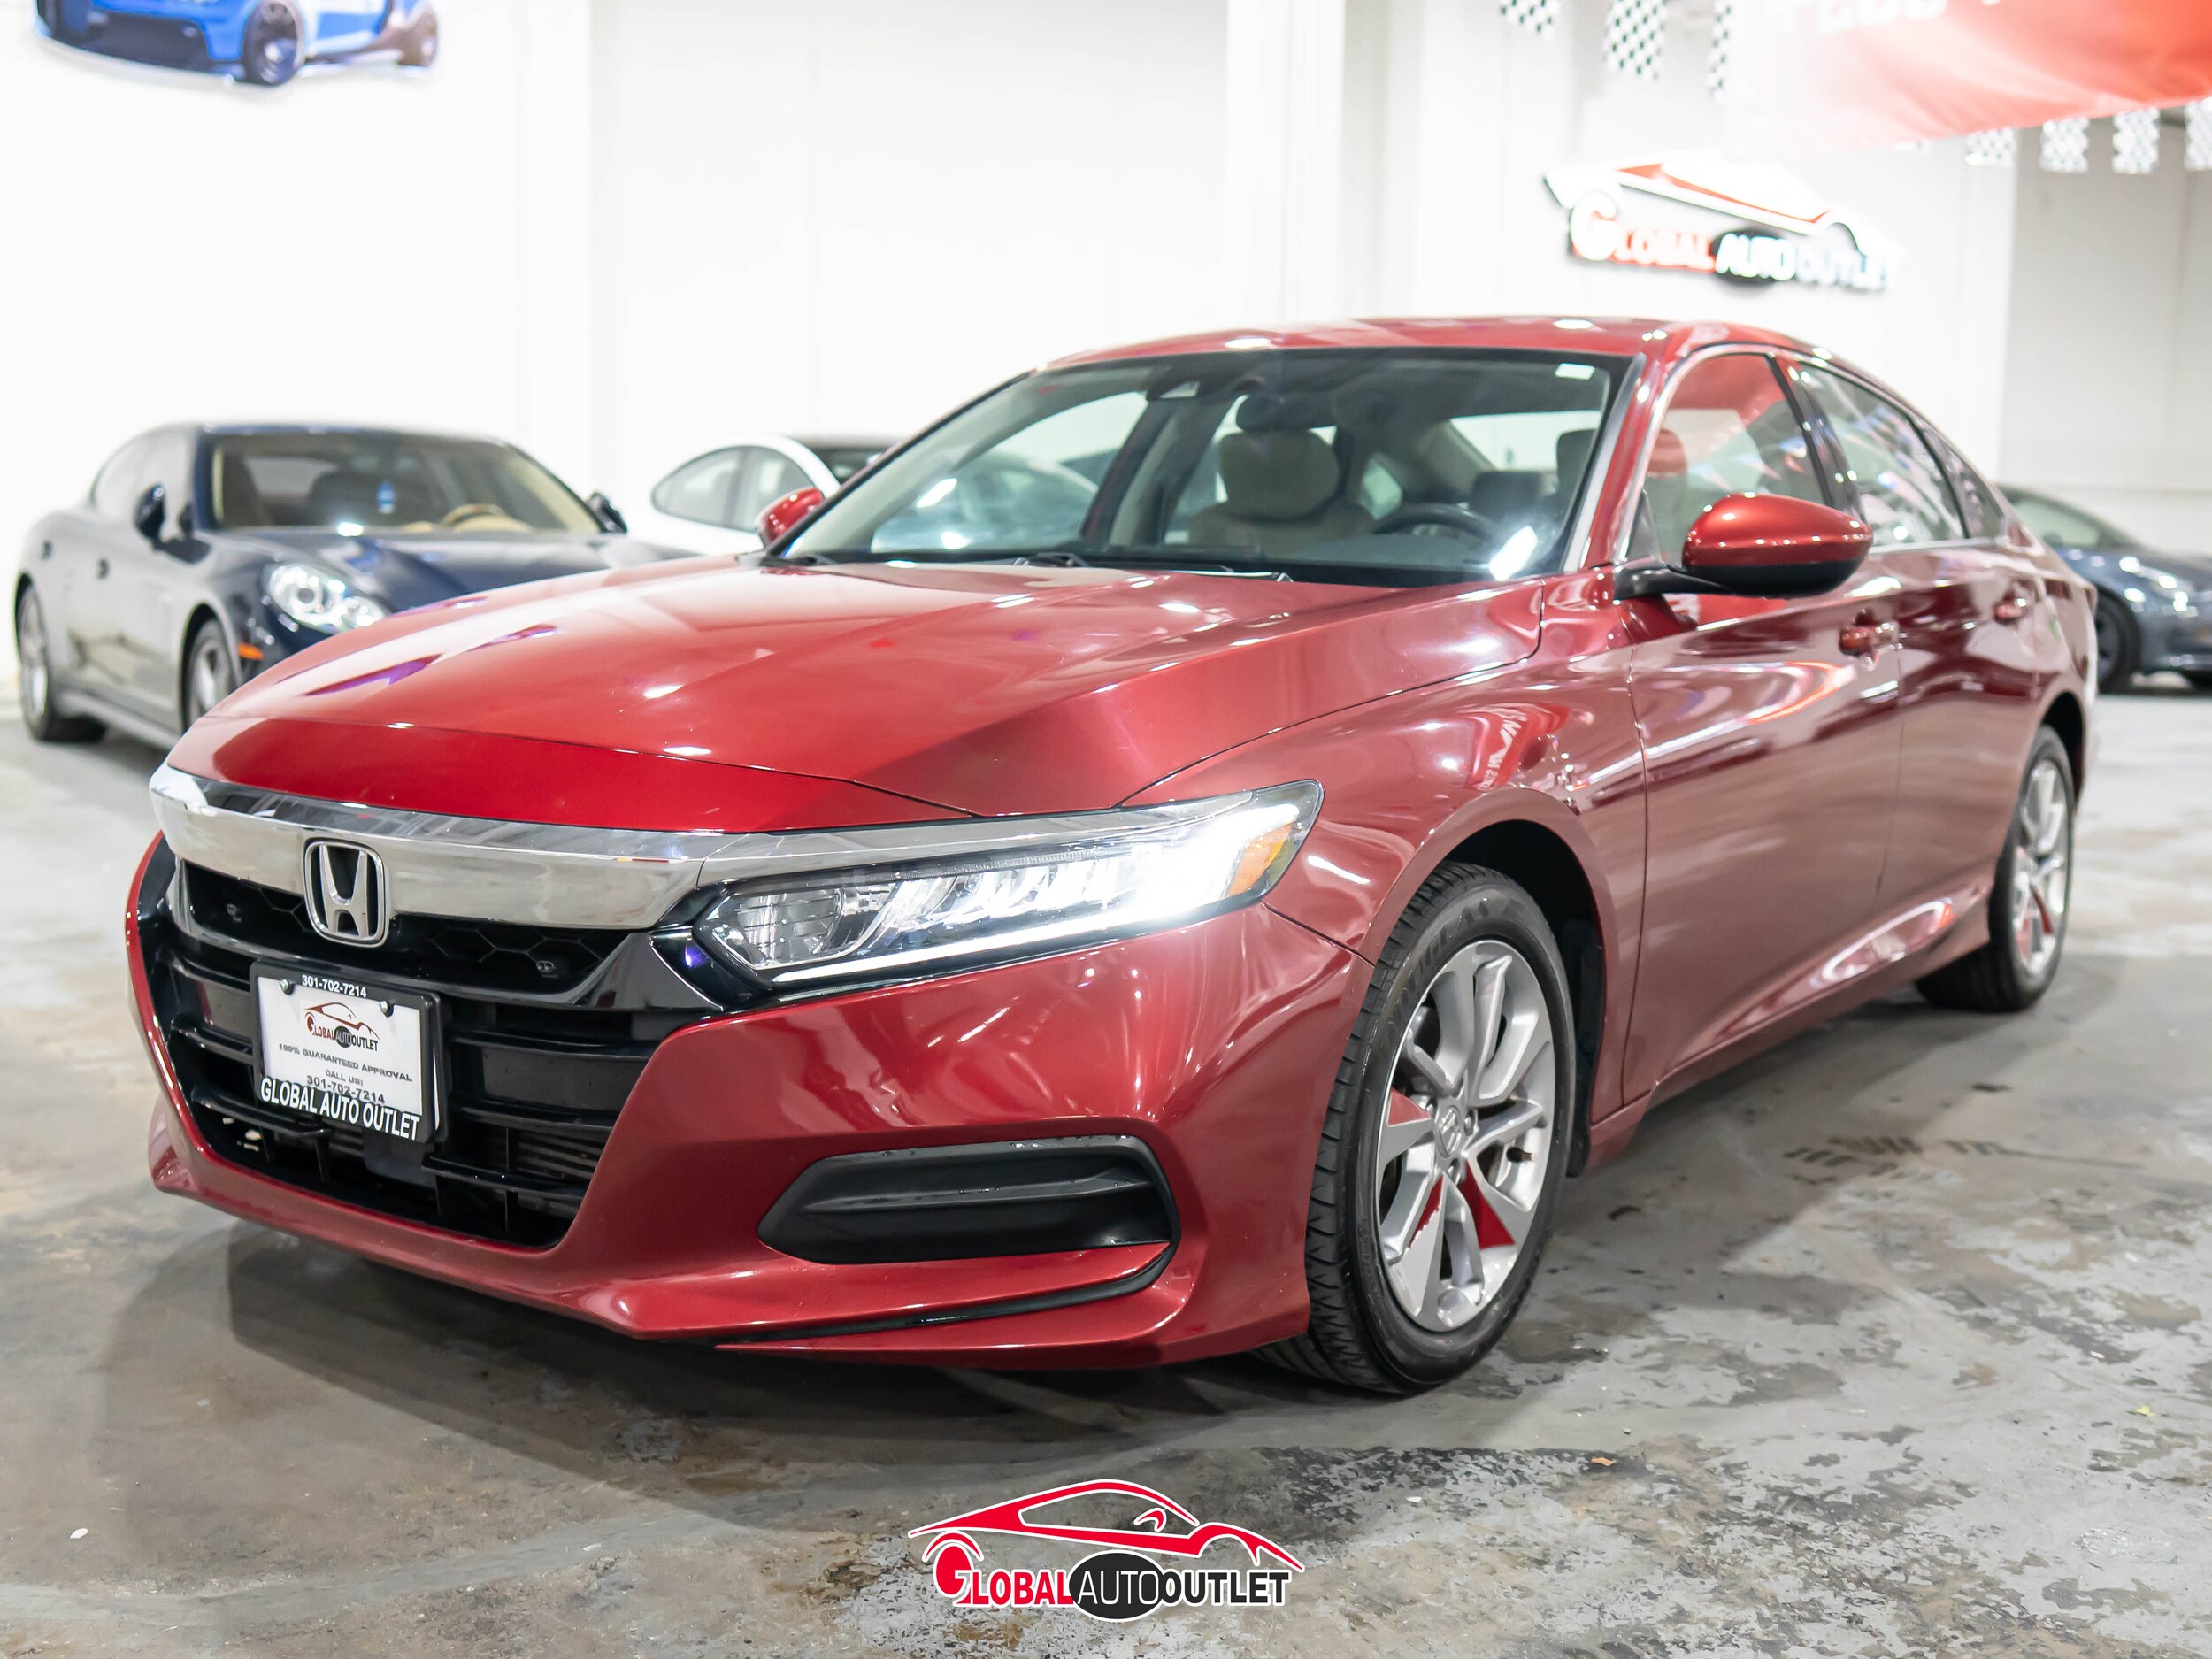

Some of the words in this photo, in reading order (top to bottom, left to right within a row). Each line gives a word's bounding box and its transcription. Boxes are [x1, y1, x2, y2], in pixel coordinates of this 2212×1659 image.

[1715, 233, 1797, 281] AUTO
[302, 974, 367, 999] 301-702-7214
[351, 1033, 379, 1052] OUTLET
[279, 1043, 301, 1055] 100%
[303, 1048, 359, 1070] GUARANTEED
[361, 1064, 413, 1082] APPROVAL
[325, 1069, 346, 1082] CALL
[306, 1075, 386, 1104] 301-702-7214
[261, 1077, 318, 1114] GLOBAL
[319, 1092, 359, 1125] AUTO
[362, 1103, 420, 1141] OUTLET
